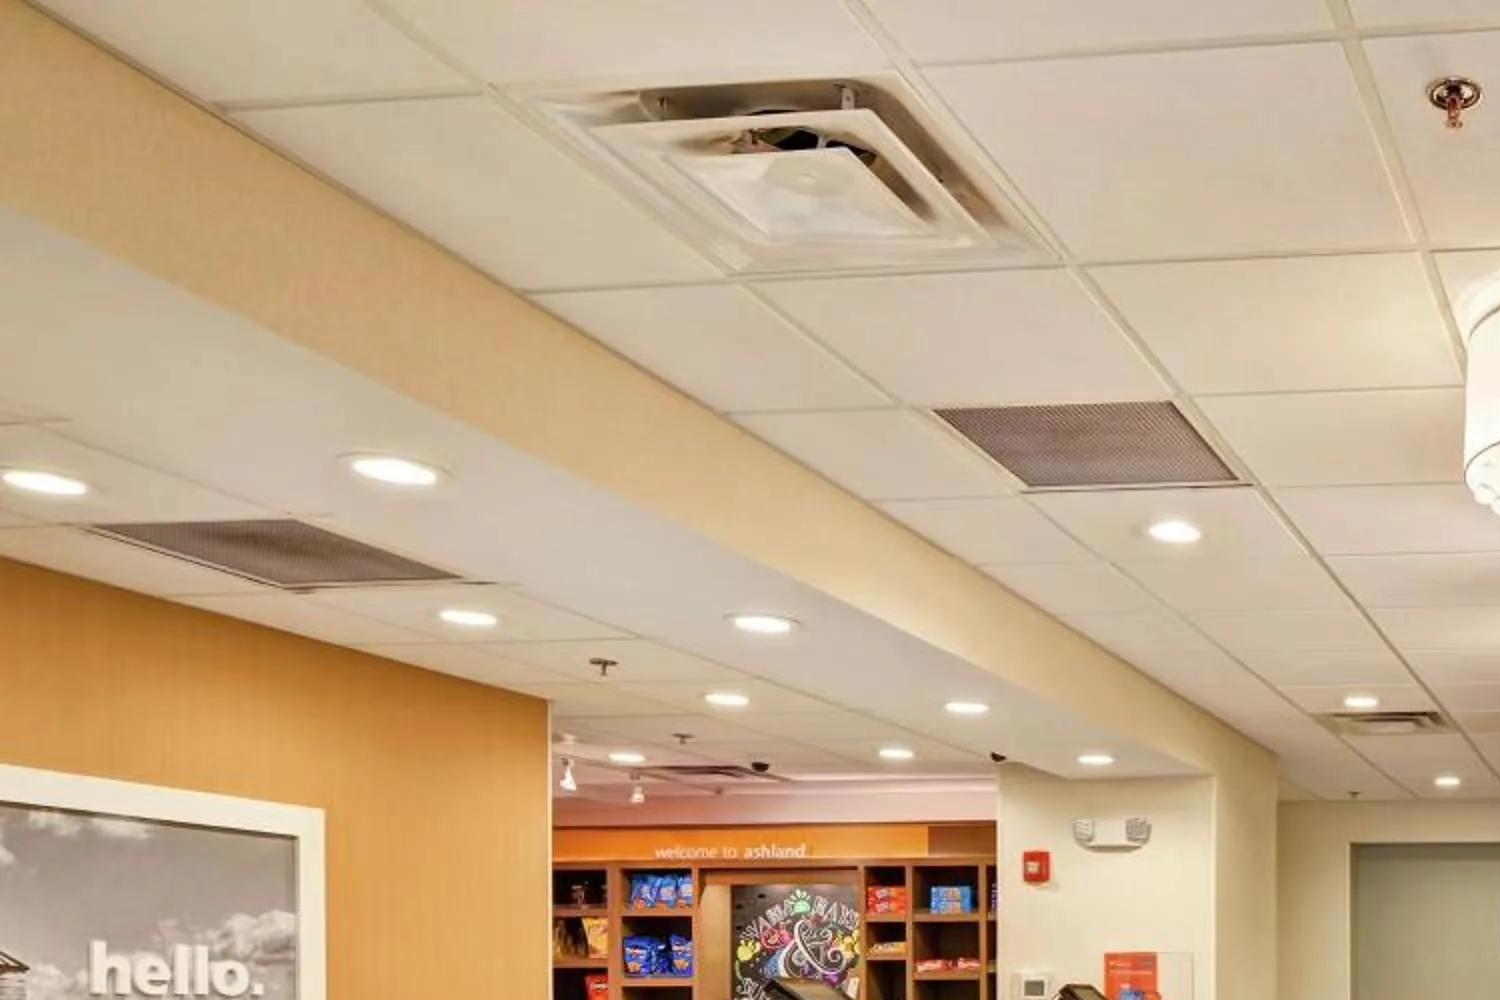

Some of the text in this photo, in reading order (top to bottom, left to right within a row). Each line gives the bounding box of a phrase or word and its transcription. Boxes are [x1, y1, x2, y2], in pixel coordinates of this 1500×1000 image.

[655, 843, 806, 859] welcome to ashland
[89, 940, 264, 997] hello.
